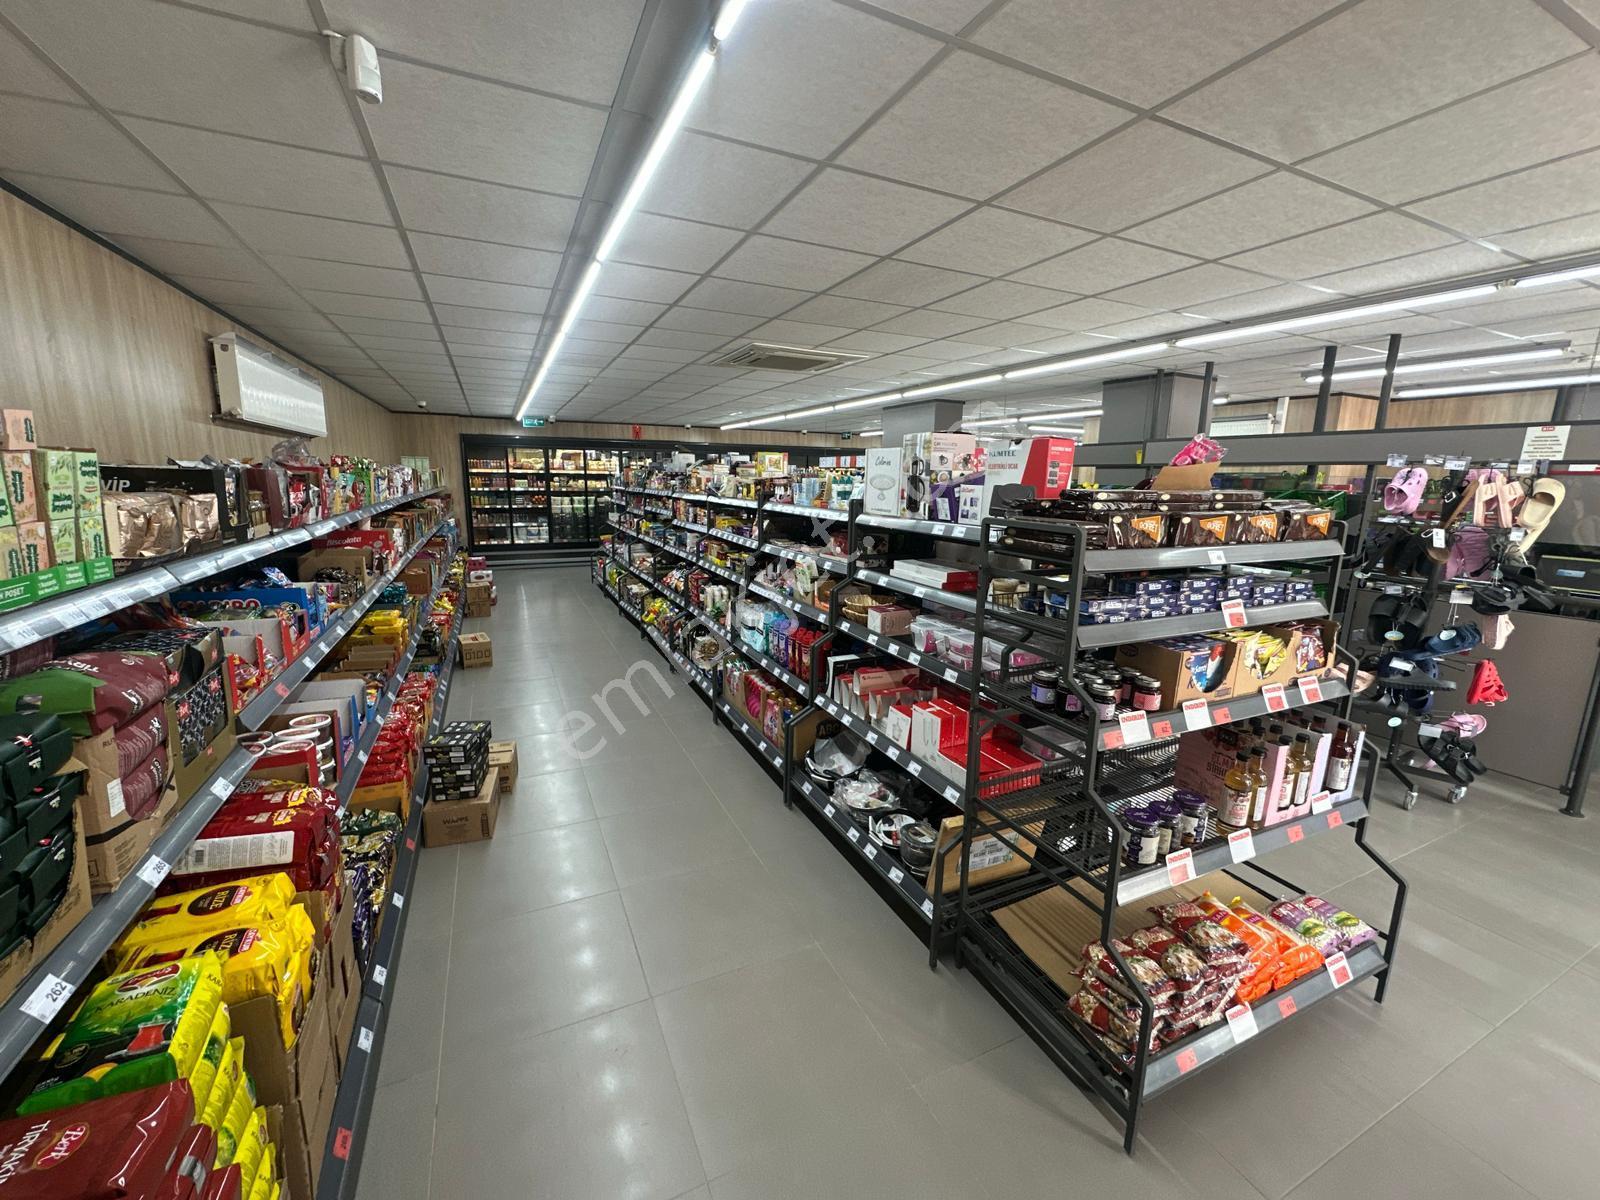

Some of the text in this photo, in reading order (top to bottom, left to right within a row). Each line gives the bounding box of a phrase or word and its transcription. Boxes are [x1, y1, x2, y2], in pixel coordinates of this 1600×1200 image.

[152, 859, 167, 875] 265
[45, 981, 67, 1003] 262
[37, 1126, 86, 1166] Berk
